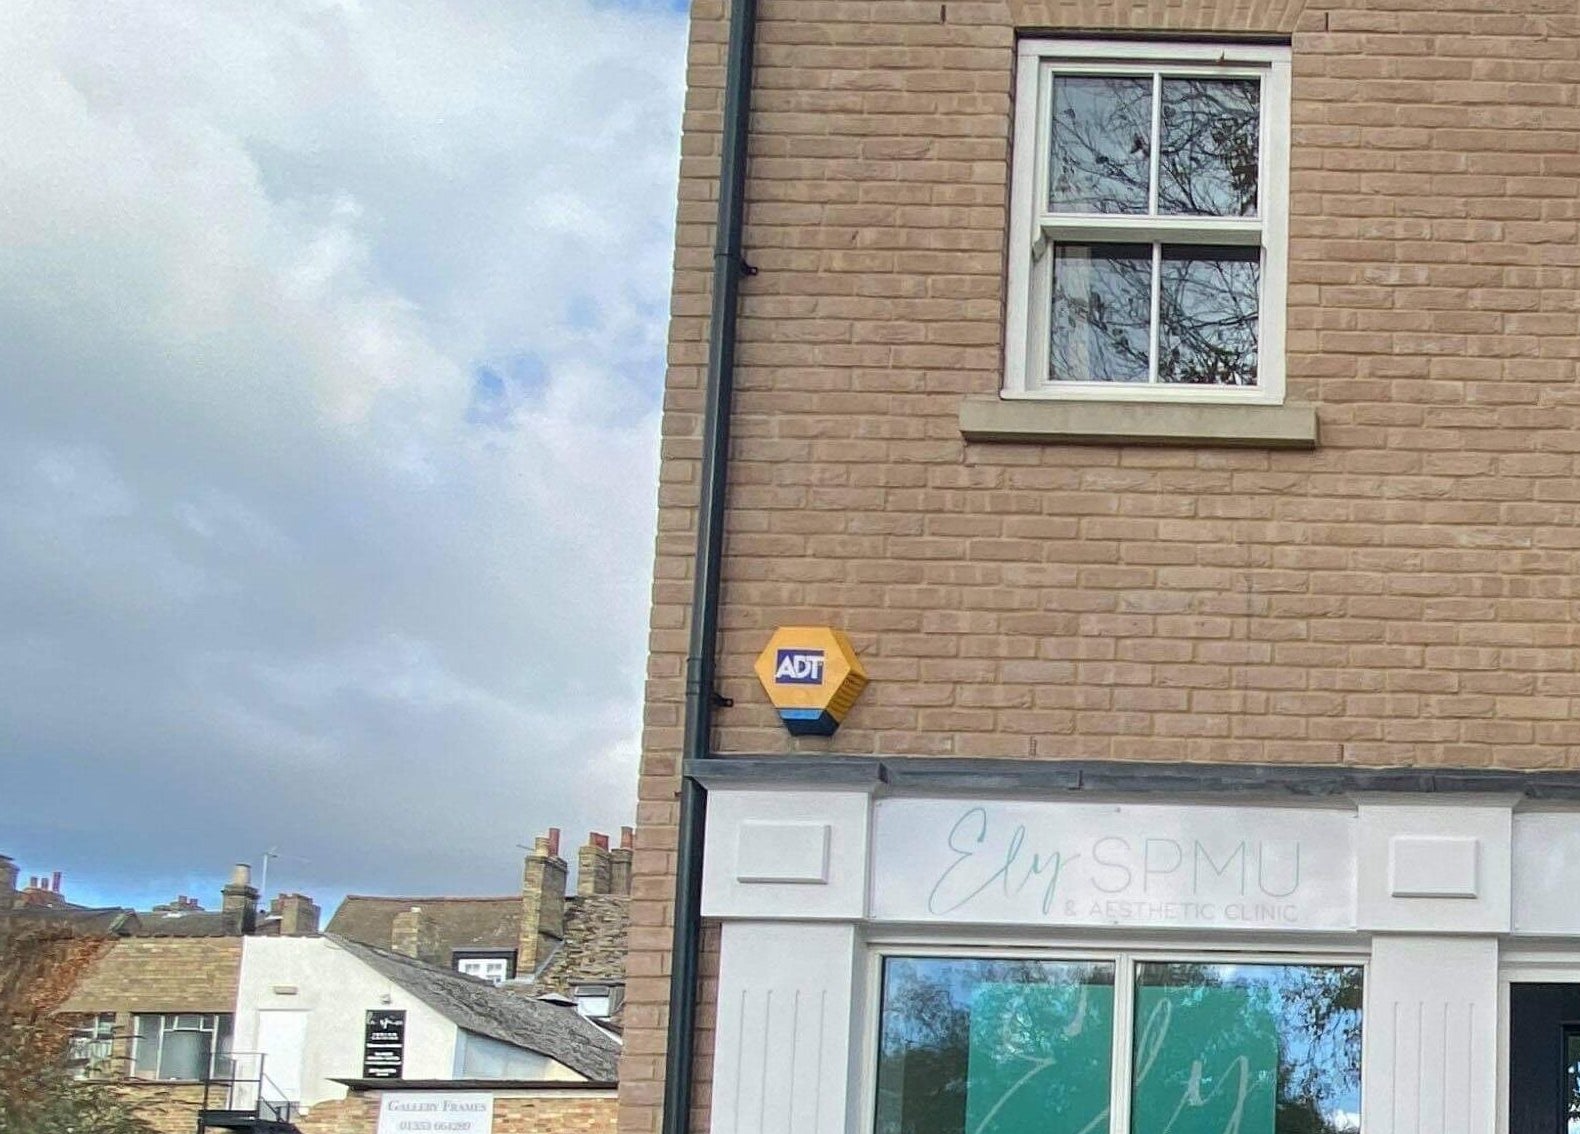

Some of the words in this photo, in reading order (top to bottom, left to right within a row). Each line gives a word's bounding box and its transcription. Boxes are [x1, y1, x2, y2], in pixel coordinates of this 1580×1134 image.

[774, 655, 826, 680] ADT
[928, 807, 1082, 916] Ely
[1091, 836, 1301, 898] SPMU
[1063, 903, 1078, 918] &
[1088, 903, 1216, 920] AESTHETIC
[1224, 904, 1300, 923] CLINIC
